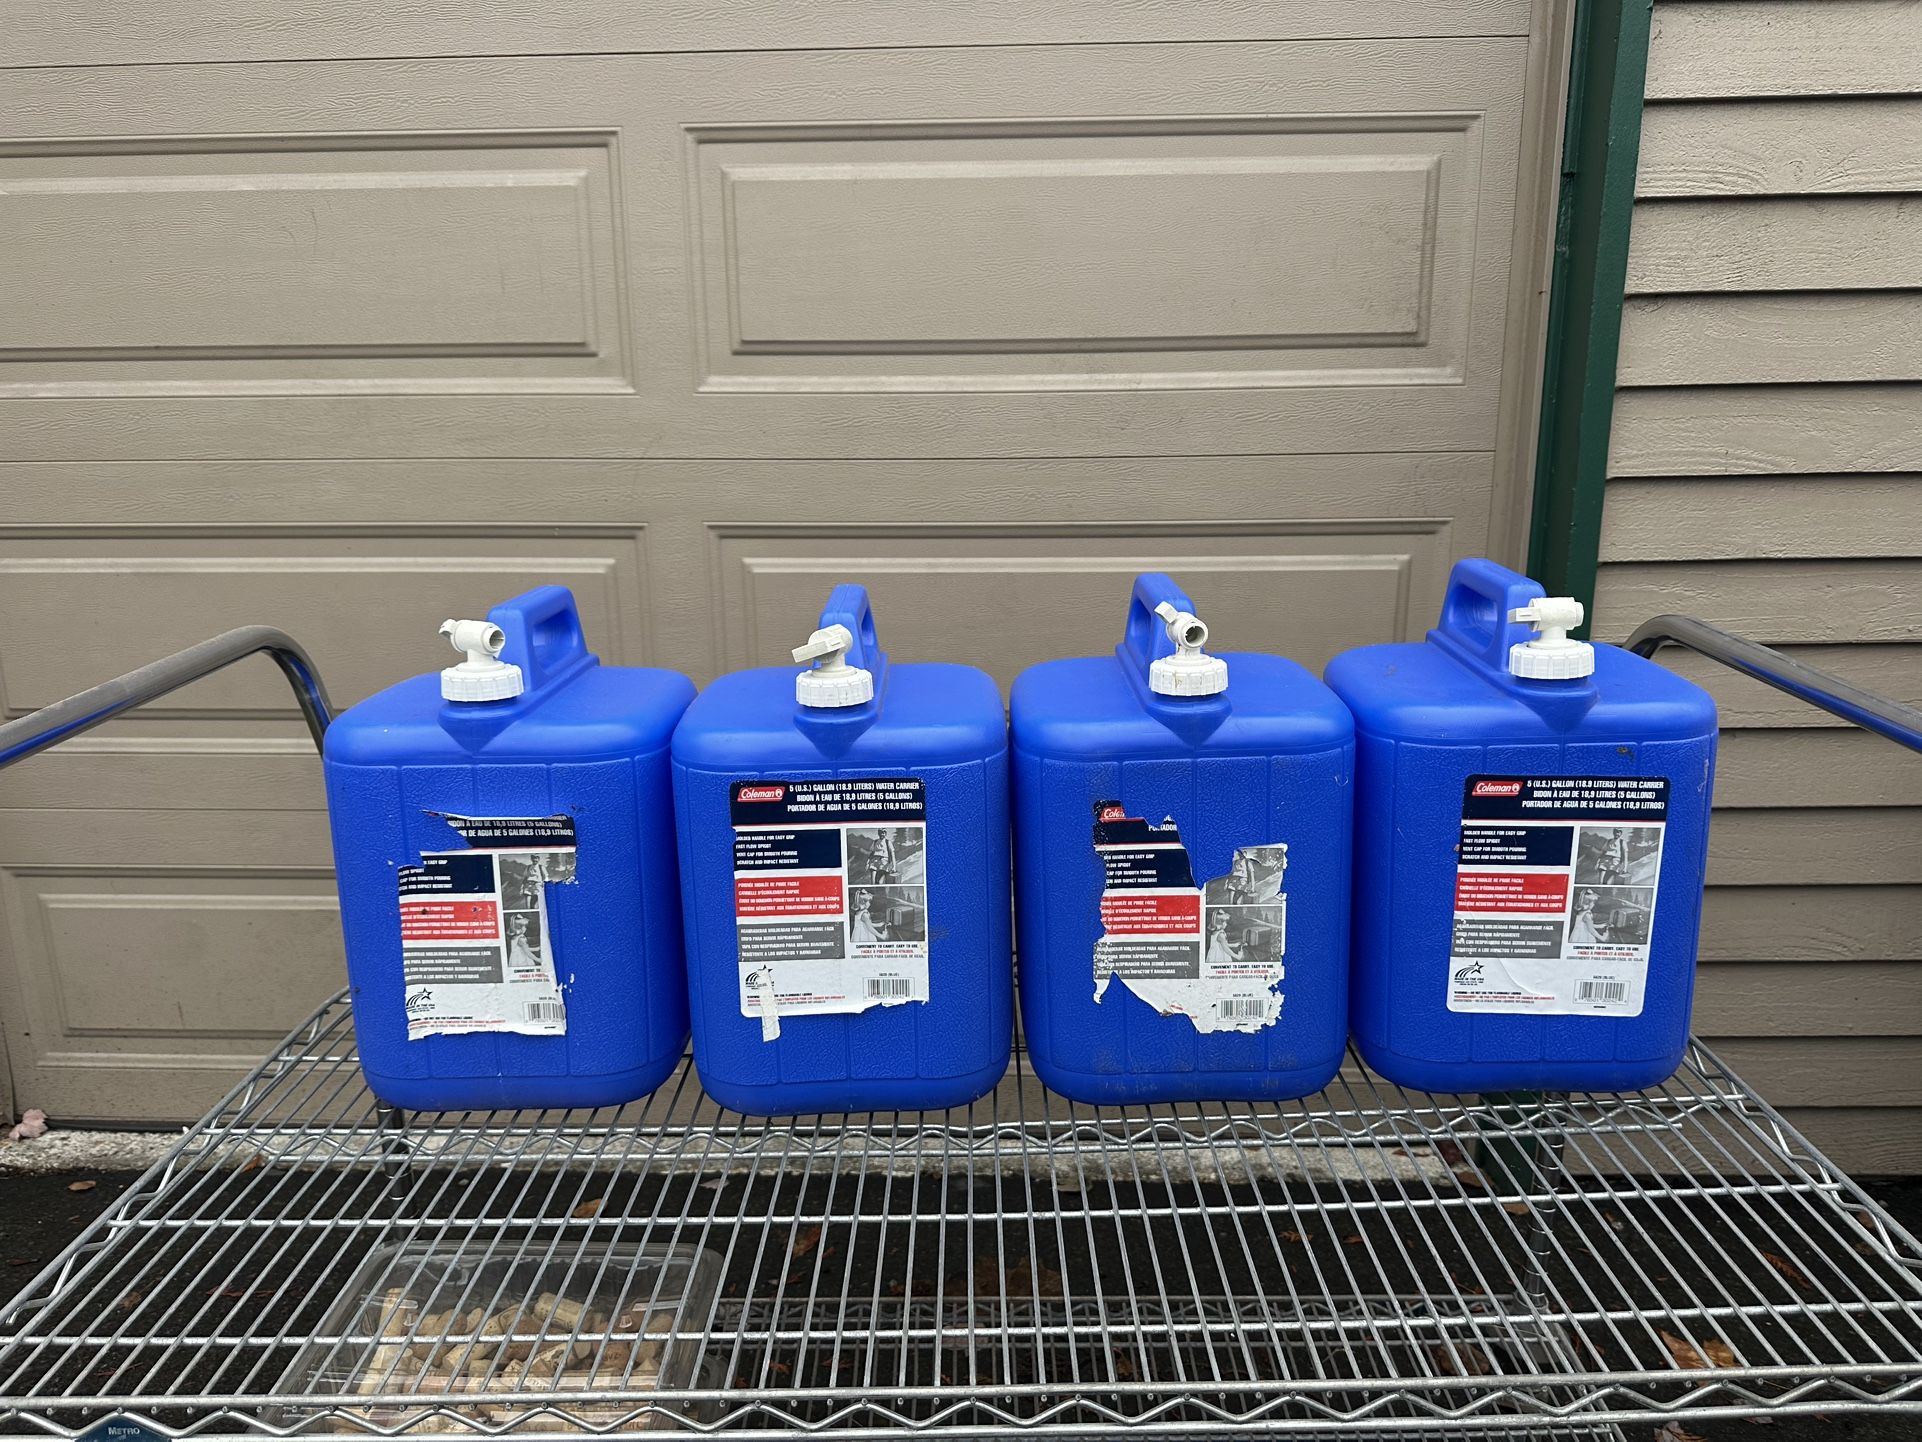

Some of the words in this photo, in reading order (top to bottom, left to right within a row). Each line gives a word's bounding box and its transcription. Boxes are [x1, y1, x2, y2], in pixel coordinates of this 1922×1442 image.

[853, 783, 874, 791] LITERS)
[1476, 782, 1511, 793] Coleman
[741, 788, 774, 798] Coleman
[797, 794, 814, 802] BIDON
[856, 793, 876, 801] LITRES
[1596, 791, 1616, 799] LITRES
[1618, 791, 1625, 799] (5
[1626, 791, 1655, 799] GALLONS)
[787, 804, 816, 812] PORTADOR
[818, 804, 825, 812] DE
[857, 803, 882, 811] GALONES
[901, 802, 922, 810] LITROS)
[1595, 801, 1621, 809] GALONES
[1623, 801, 1640, 809] (18,9
